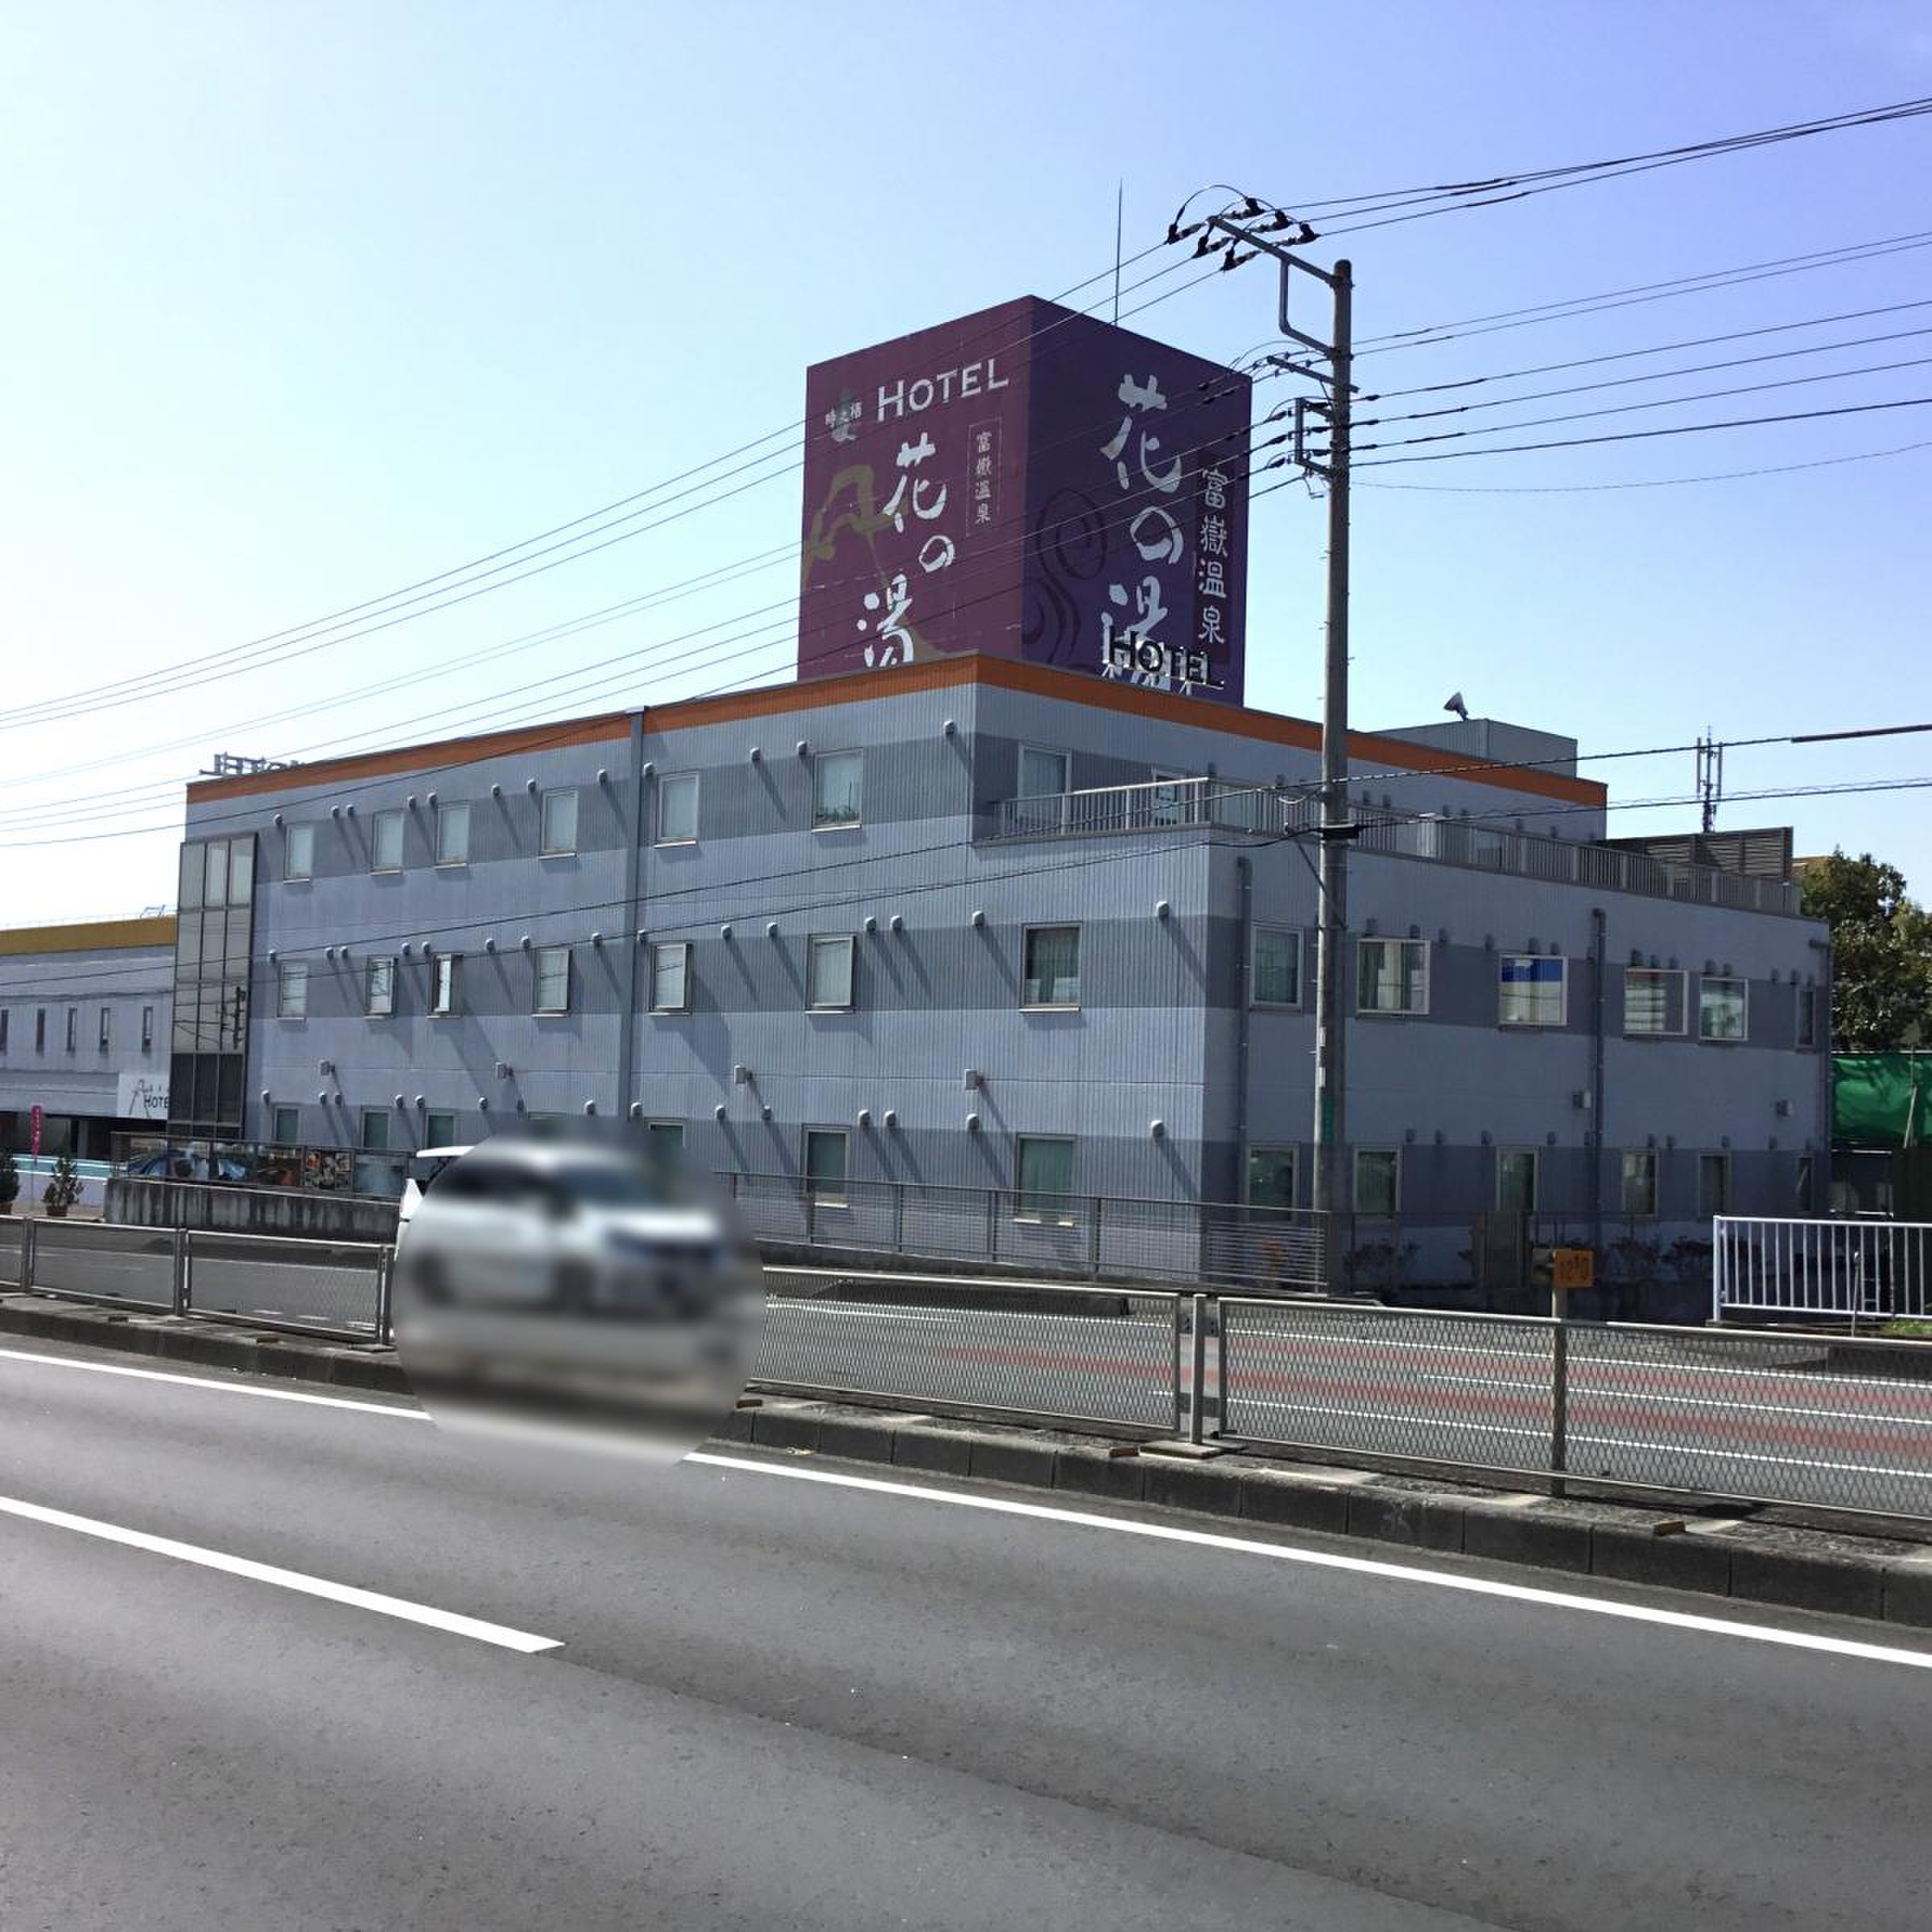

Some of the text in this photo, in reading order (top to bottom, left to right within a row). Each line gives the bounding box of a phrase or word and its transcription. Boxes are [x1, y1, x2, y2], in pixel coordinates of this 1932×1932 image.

[877, 358, 1009, 423] HOTEL
[857, 432, 955, 667] 花の湯
[1100, 374, 1185, 691] 花の湯
